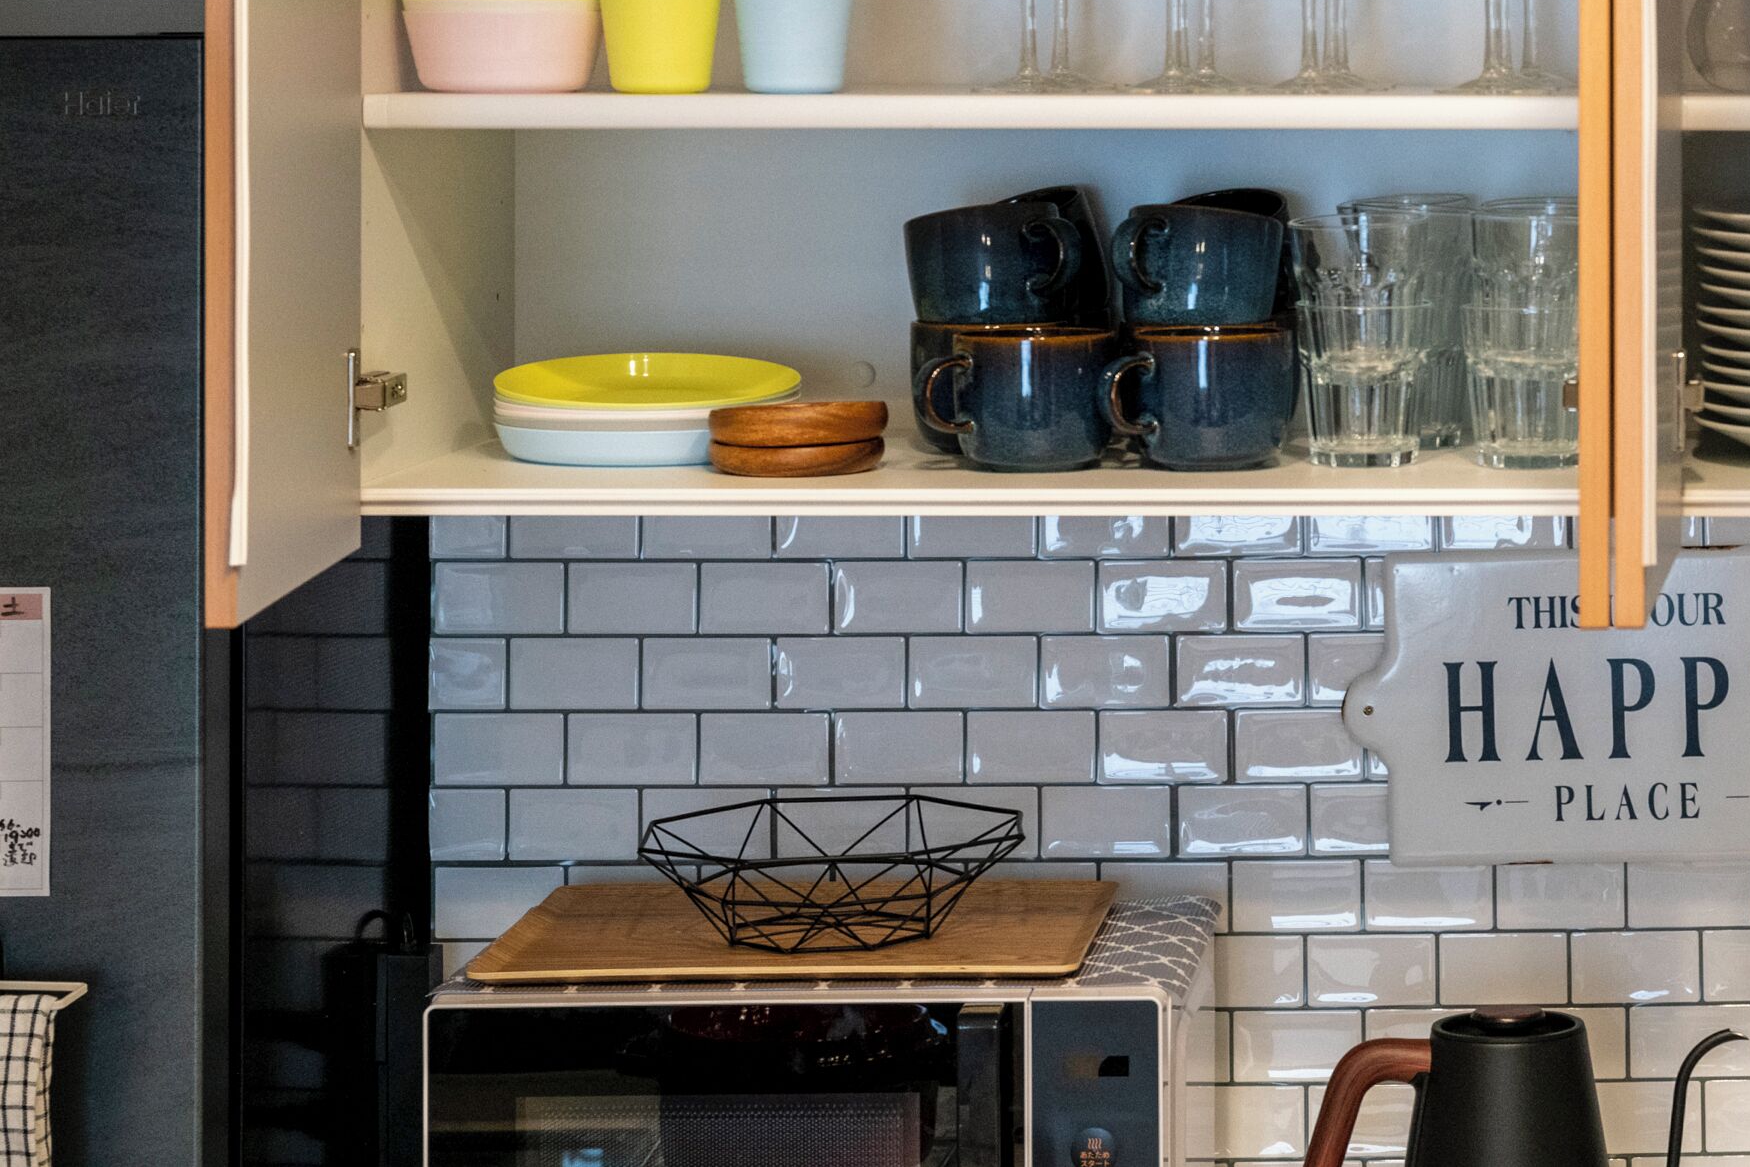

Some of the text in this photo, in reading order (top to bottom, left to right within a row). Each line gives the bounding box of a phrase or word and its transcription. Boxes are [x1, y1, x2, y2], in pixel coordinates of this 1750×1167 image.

[65, 91, 141, 115] Haier
[1, 596, 25, 616] 土
[1650, 592, 1727, 627] OUR
[1554, 782, 1702, 822] PLACE
